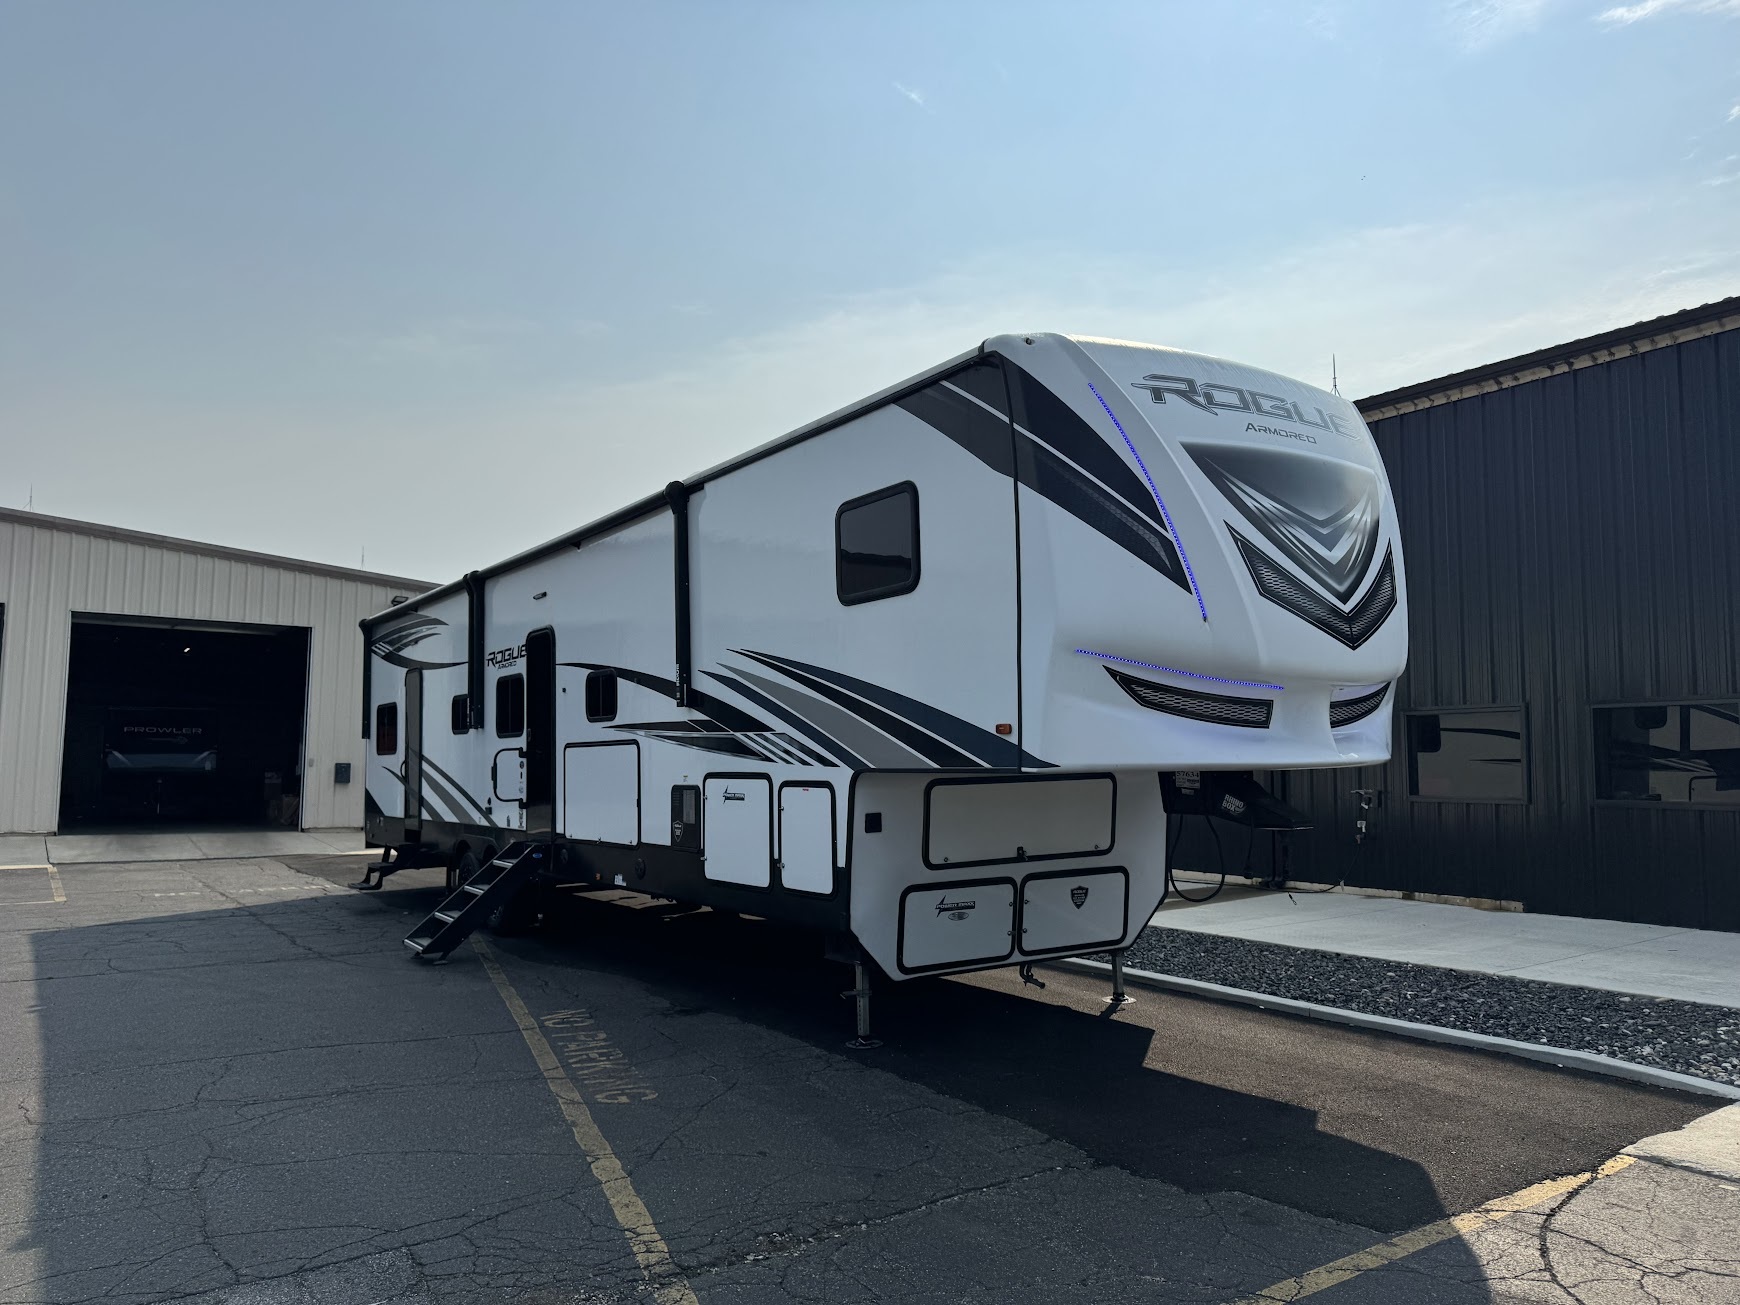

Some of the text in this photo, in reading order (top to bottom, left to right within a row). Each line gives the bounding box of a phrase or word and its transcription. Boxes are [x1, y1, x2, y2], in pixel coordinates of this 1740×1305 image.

[1130, 373, 1361, 441] ROGUE
[1244, 422, 1318, 444] ARMORED
[486, 643, 527, 668] ROGUE
[123, 726, 203, 734] PROWLER
[1222, 800, 1235, 811] BOX
[1224, 794, 1244, 808] RHINO
[551, 1030, 659, 1104] PARKING
